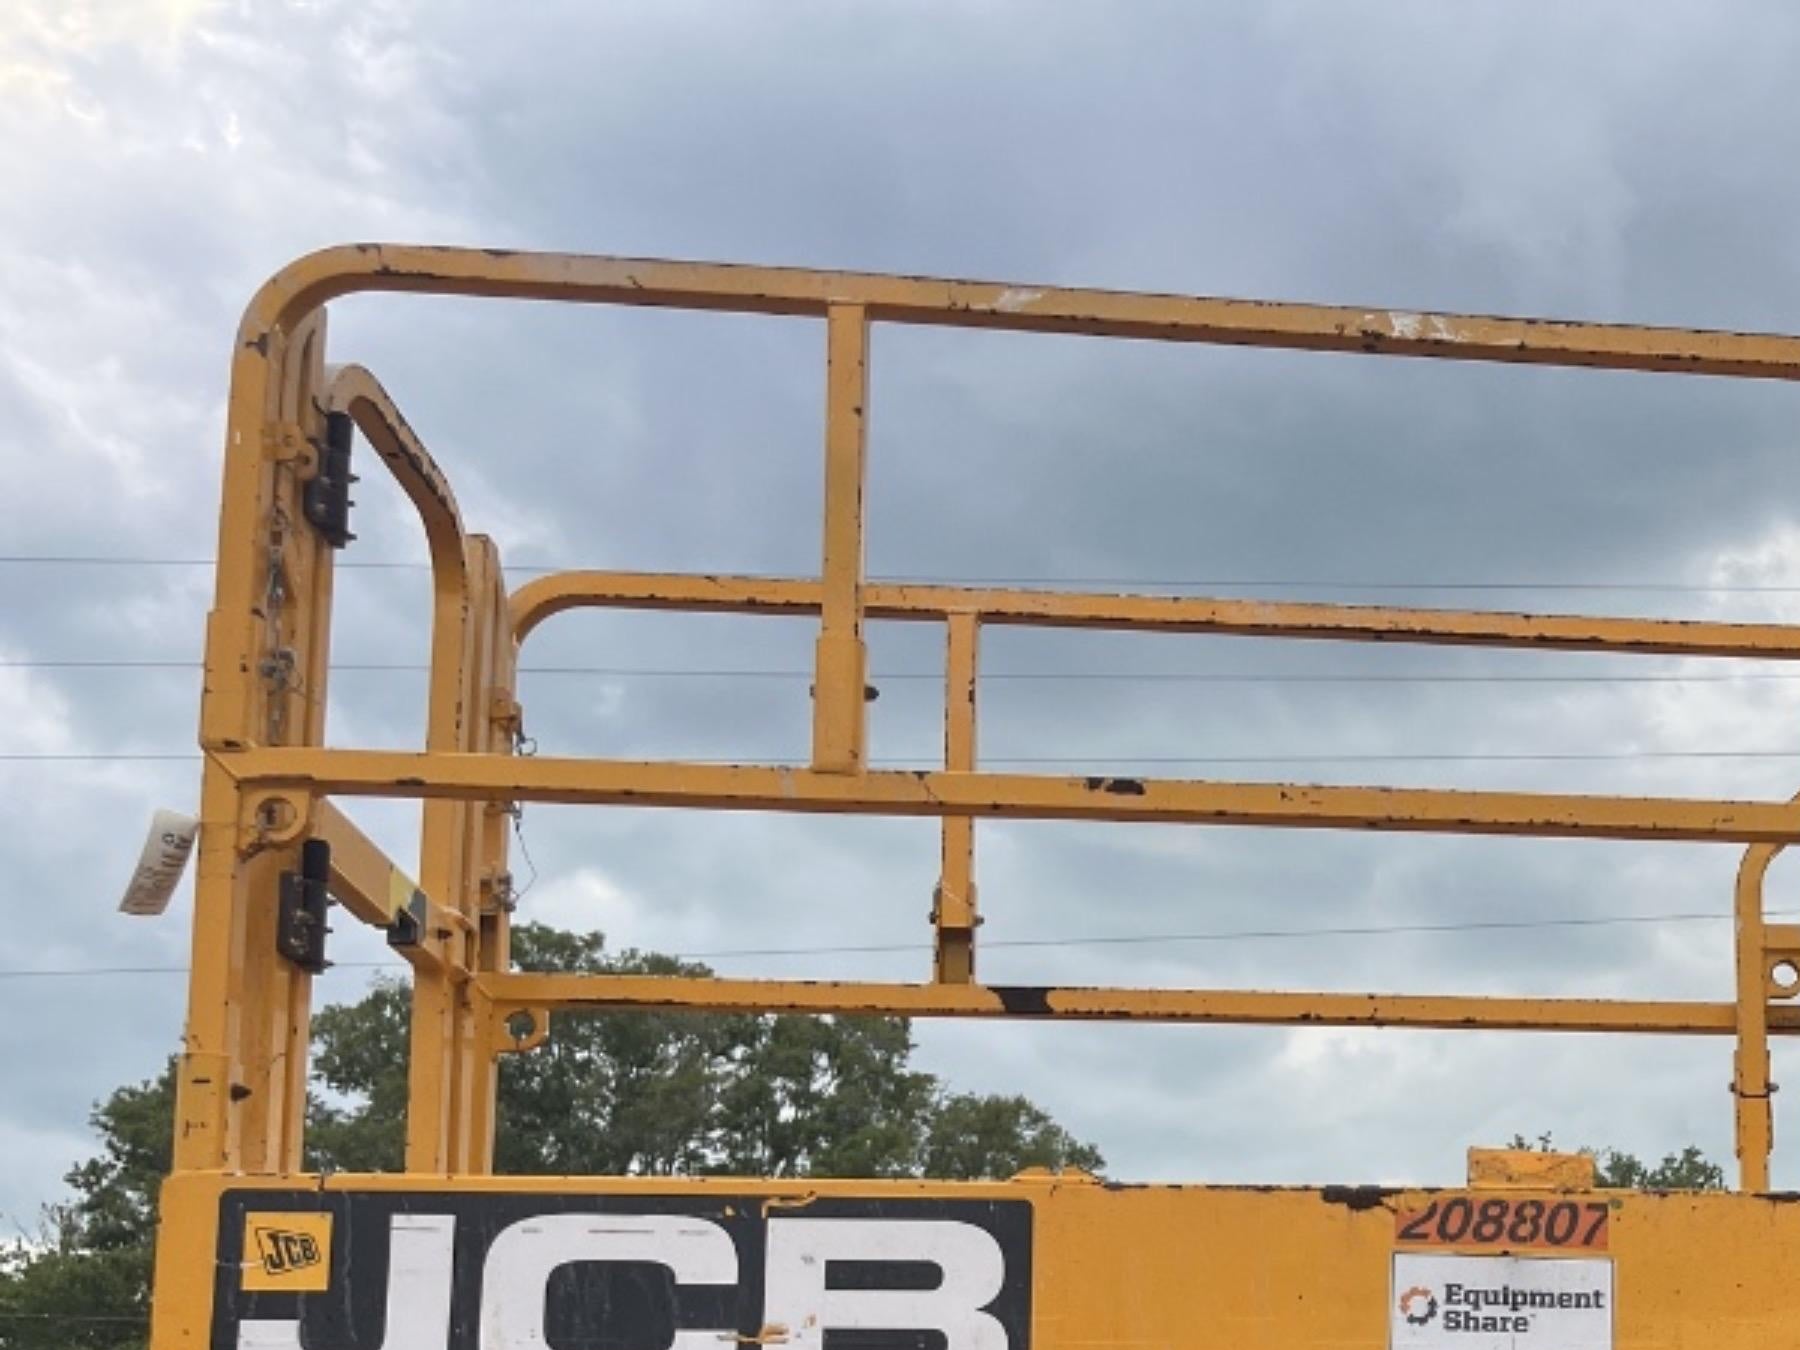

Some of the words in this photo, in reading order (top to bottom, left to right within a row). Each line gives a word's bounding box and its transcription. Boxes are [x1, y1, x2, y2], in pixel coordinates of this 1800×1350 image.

[1396, 1197, 1609, 1246] 208807
[262, 1230, 318, 1270] JCB
[1443, 1283, 1605, 1312] Equipment
[1442, 1310, 1530, 1333] Share
